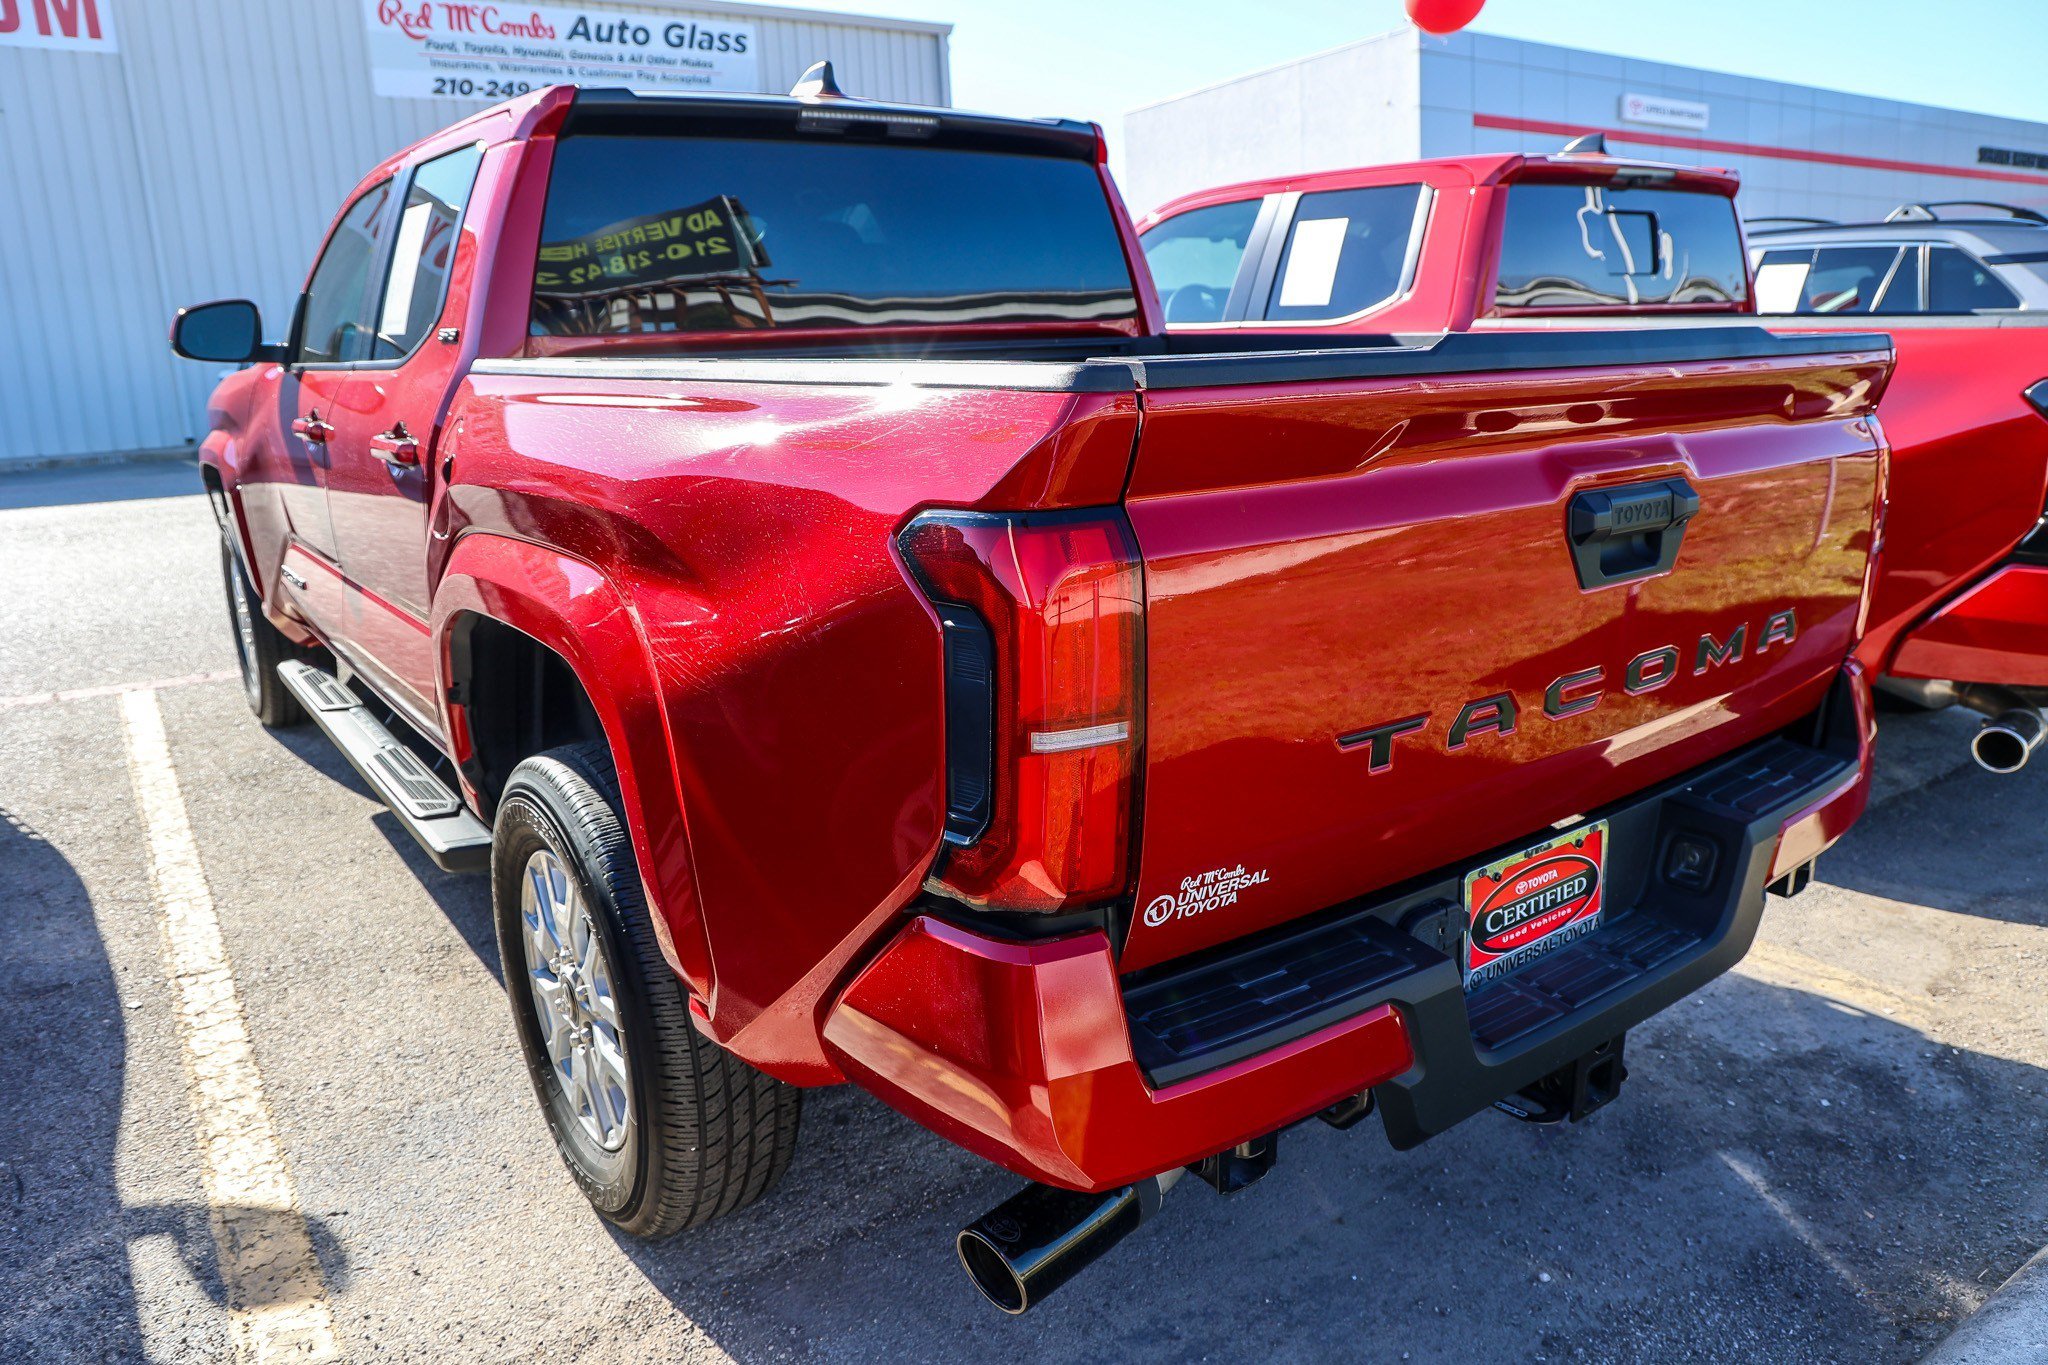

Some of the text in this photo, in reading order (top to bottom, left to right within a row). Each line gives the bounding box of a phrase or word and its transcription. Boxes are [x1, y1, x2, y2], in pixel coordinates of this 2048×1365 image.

[378, 0, 433, 40] Red
[566, 15, 651, 46] Auto
[663, 20, 748, 53] Glass
[617, 52, 625, 62] &
[1614, 499, 1670, 526] TOYOTA
[1335, 606, 1797, 776] TACOMA
[1177, 869, 1271, 907] UNIVERSAL
[1180, 873, 1204, 894] Red
[1527, 869, 1559, 890] TOYOTA
[1176, 891, 1238, 920] TOYOTA
[1502, 906, 1573, 944] Used Vehicles
